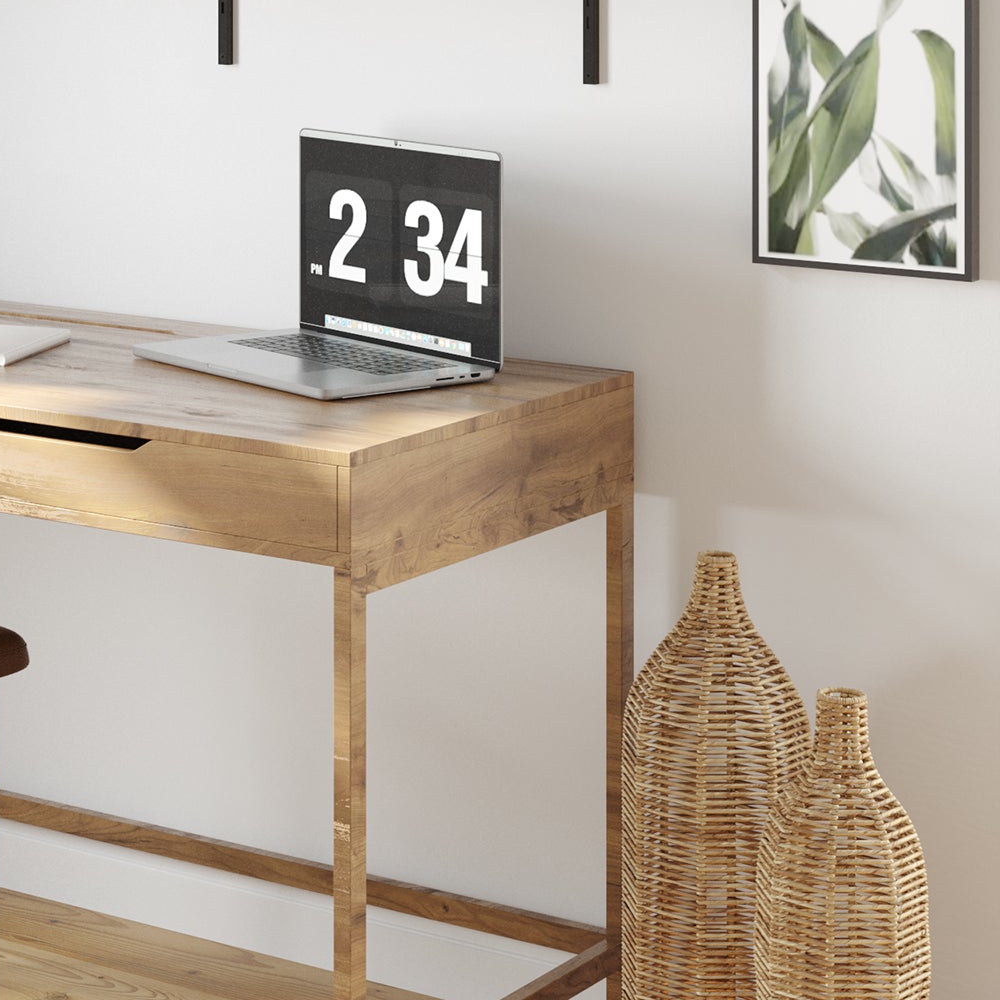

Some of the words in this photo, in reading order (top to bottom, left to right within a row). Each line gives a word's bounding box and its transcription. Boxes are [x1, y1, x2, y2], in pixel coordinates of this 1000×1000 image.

[310, 263, 323, 276] PM
[329, 189, 367, 283] 2
[403, 200, 489, 304] 34
